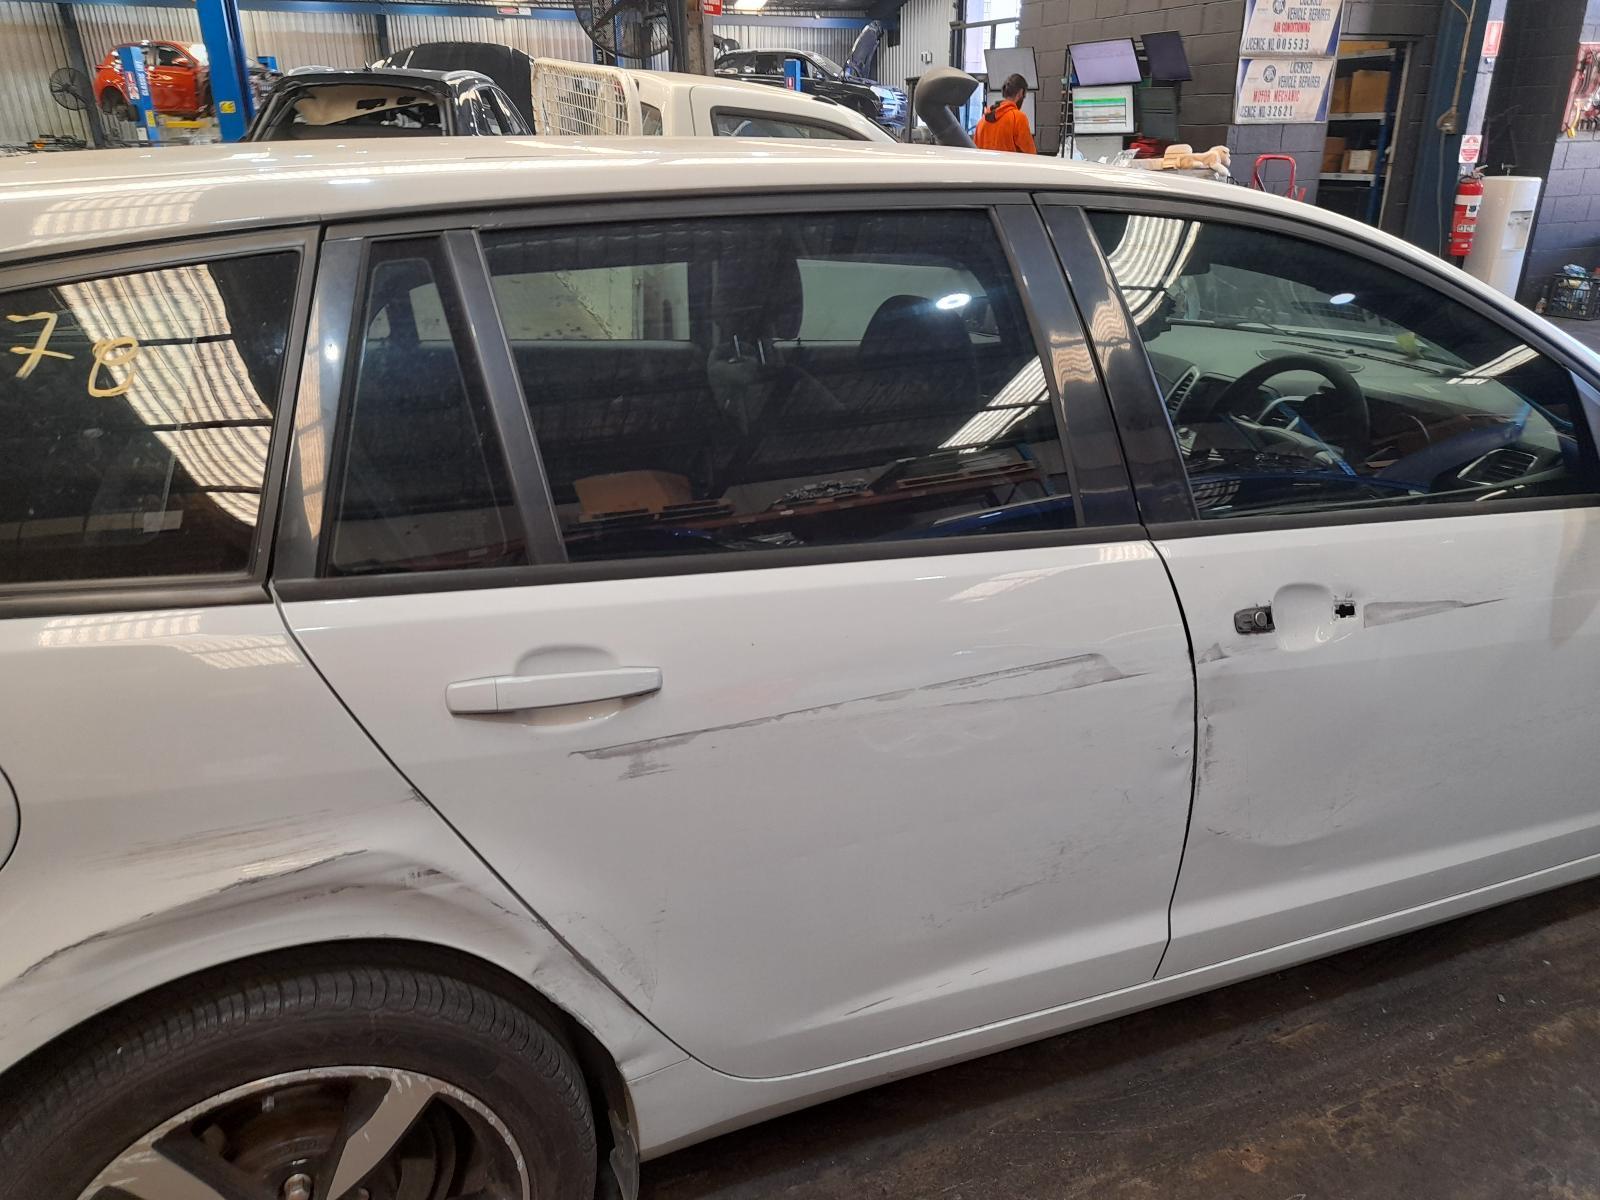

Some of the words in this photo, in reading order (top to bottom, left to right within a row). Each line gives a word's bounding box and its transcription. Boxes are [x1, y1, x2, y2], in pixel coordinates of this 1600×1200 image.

[1288, 7, 1307, 20] VEHICLE
[1308, 8, 1331, 21] REPAIRER
[1282, 21, 1311, 33] CONDITIONING
[1276, 38, 1309, 50] 005533
[1290, 61, 1313, 74] LICENSED
[1278, 76, 1297, 89] VEHICLE
[1298, 76, 1321, 89] REPAIRER
[1252, 90, 1271, 103] MOTOR
[1273, 89, 1301, 103] MECHANIC
[1267, 106, 1293, 117] 32621
